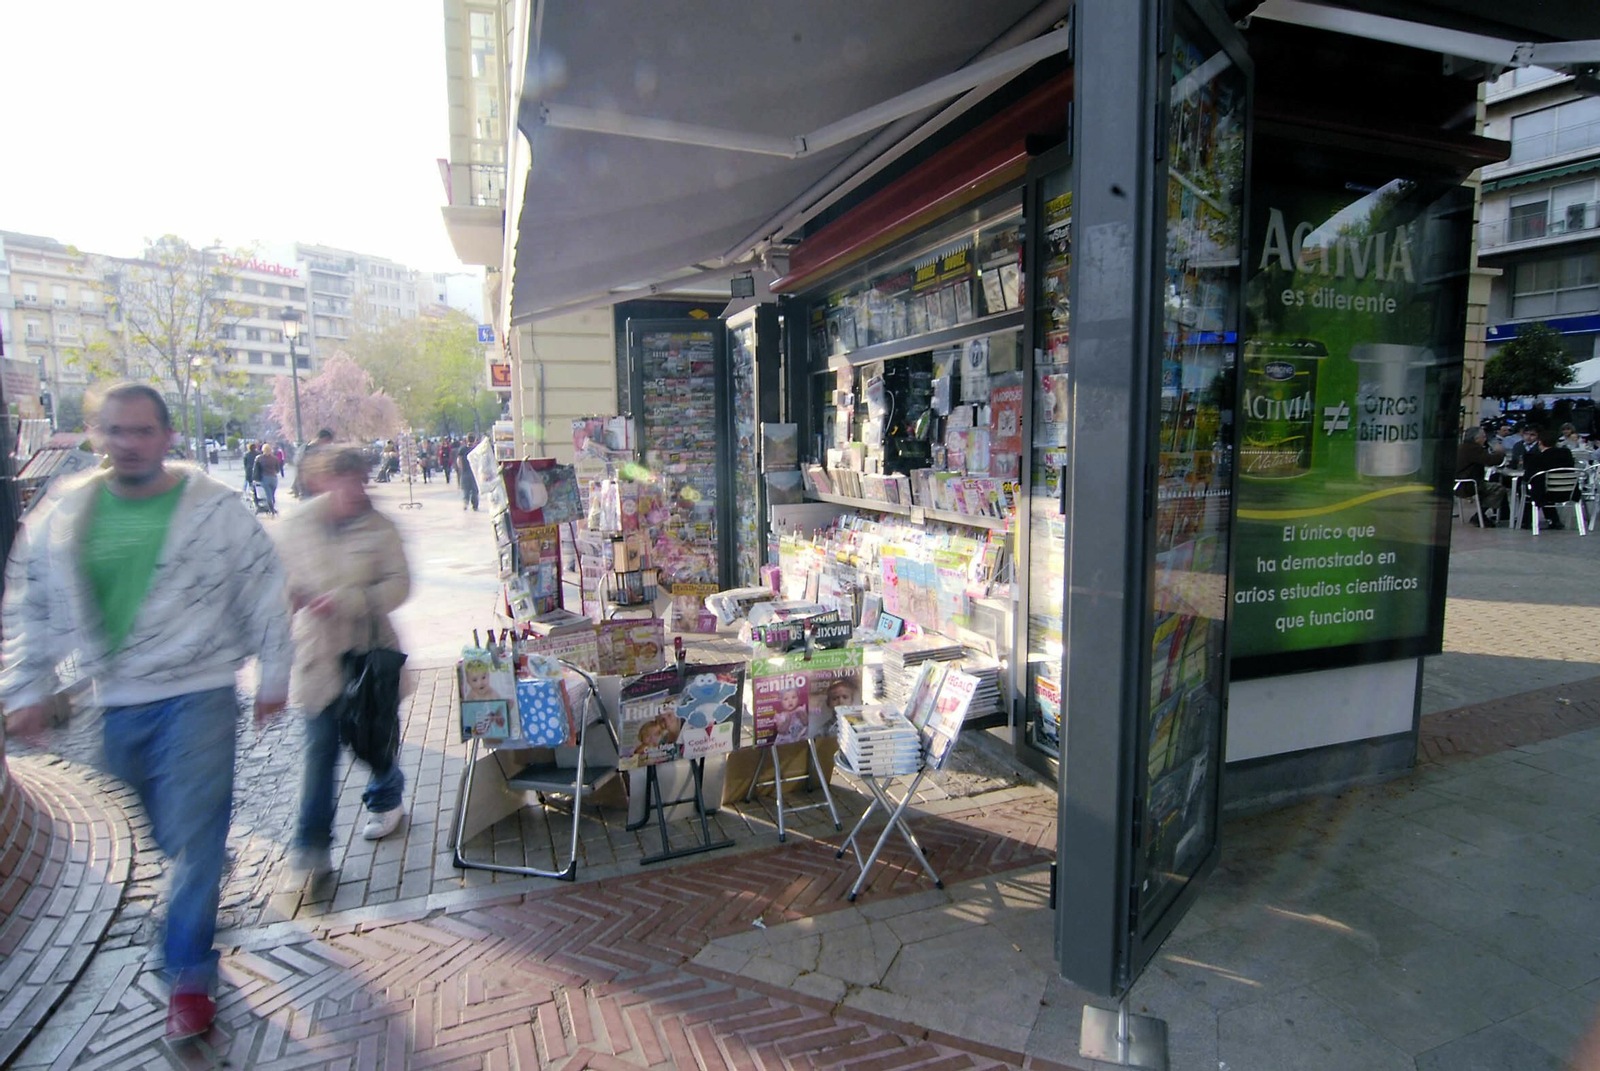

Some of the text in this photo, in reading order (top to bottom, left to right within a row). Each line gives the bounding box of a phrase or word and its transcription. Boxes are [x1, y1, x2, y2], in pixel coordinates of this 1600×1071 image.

[1260, 207, 1415, 284] ACTIVIA
[221, 253, 300, 278] bankinter
[1282, 286, 1397, 314] es diferente
[1242, 388, 1312, 420] ACTIVIA
[1364, 395, 1418, 415] OTROS
[1283, 523, 1376, 543] El único que
[1257, 550, 1396, 573] ha demostrado en
[1235, 574, 1418, 605] arios estudios científicos
[1275, 607, 1375, 633] que funciona
[769, 674, 806, 692] niño
